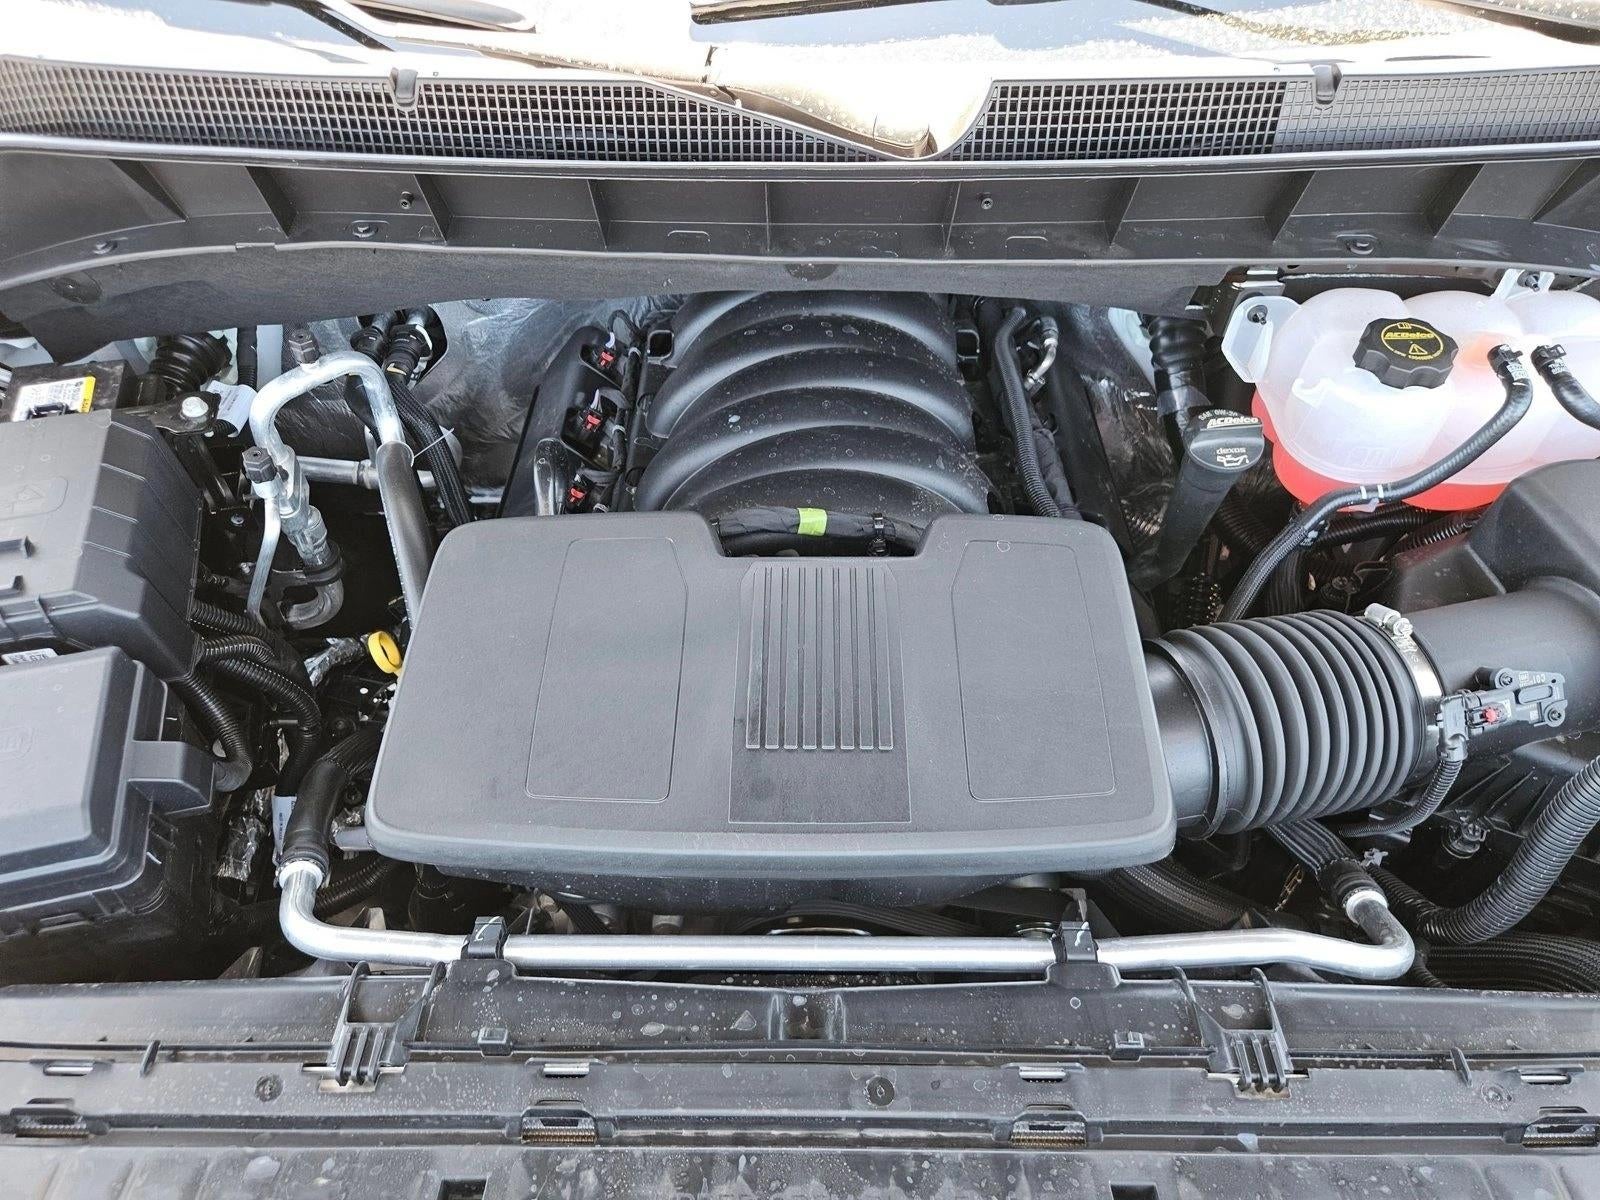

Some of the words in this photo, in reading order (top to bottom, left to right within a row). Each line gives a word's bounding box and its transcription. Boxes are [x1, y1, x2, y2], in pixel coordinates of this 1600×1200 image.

[1384, 331, 1435, 340] ACDelco
[1206, 415, 1259, 429] ACDelco
[1216, 447, 1246, 455] dexos
